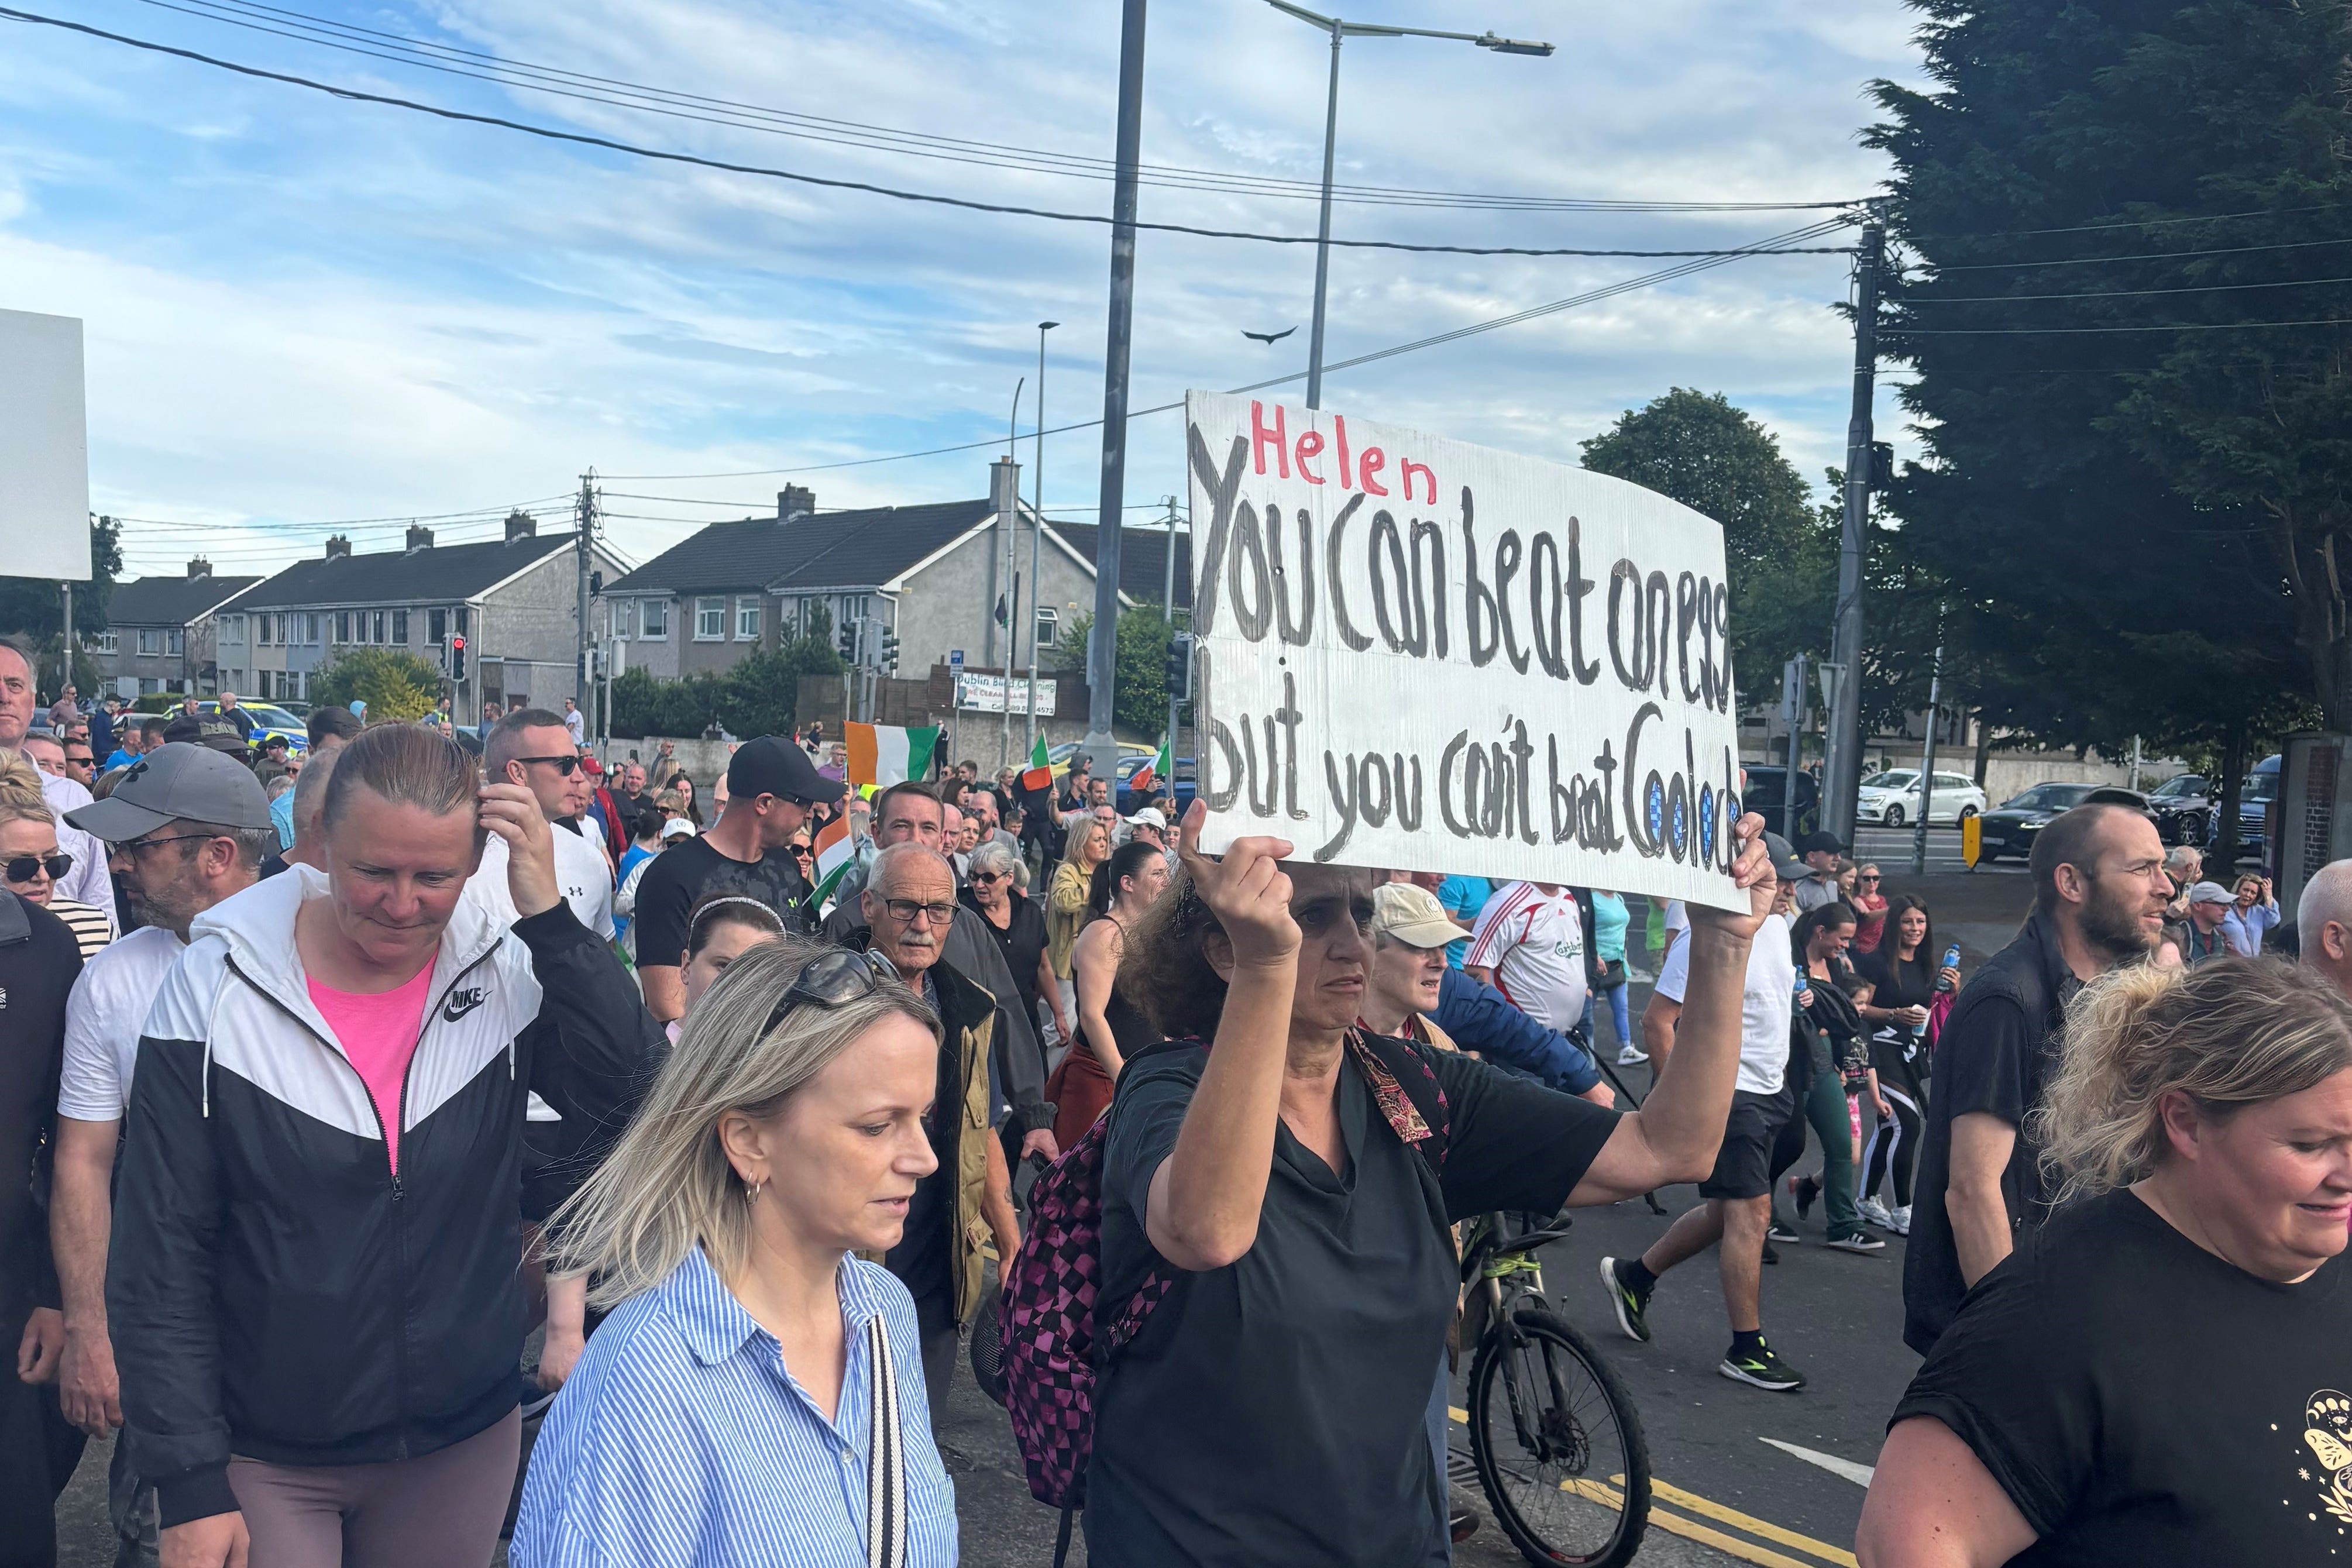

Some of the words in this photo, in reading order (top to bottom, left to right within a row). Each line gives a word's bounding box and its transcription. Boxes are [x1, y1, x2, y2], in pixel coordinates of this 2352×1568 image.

[1251, 400, 1436, 504] Helen
[1190, 422, 1315, 647] You
[1461, 486, 1600, 685] beat
[1607, 558, 1670, 700] an
[1676, 570, 1732, 716] egg
[1196, 646, 1309, 820] but
[1313, 749, 1422, 862] you
[1548, 733, 1624, 855] beat
[451, 987, 482, 1009] NIKE
